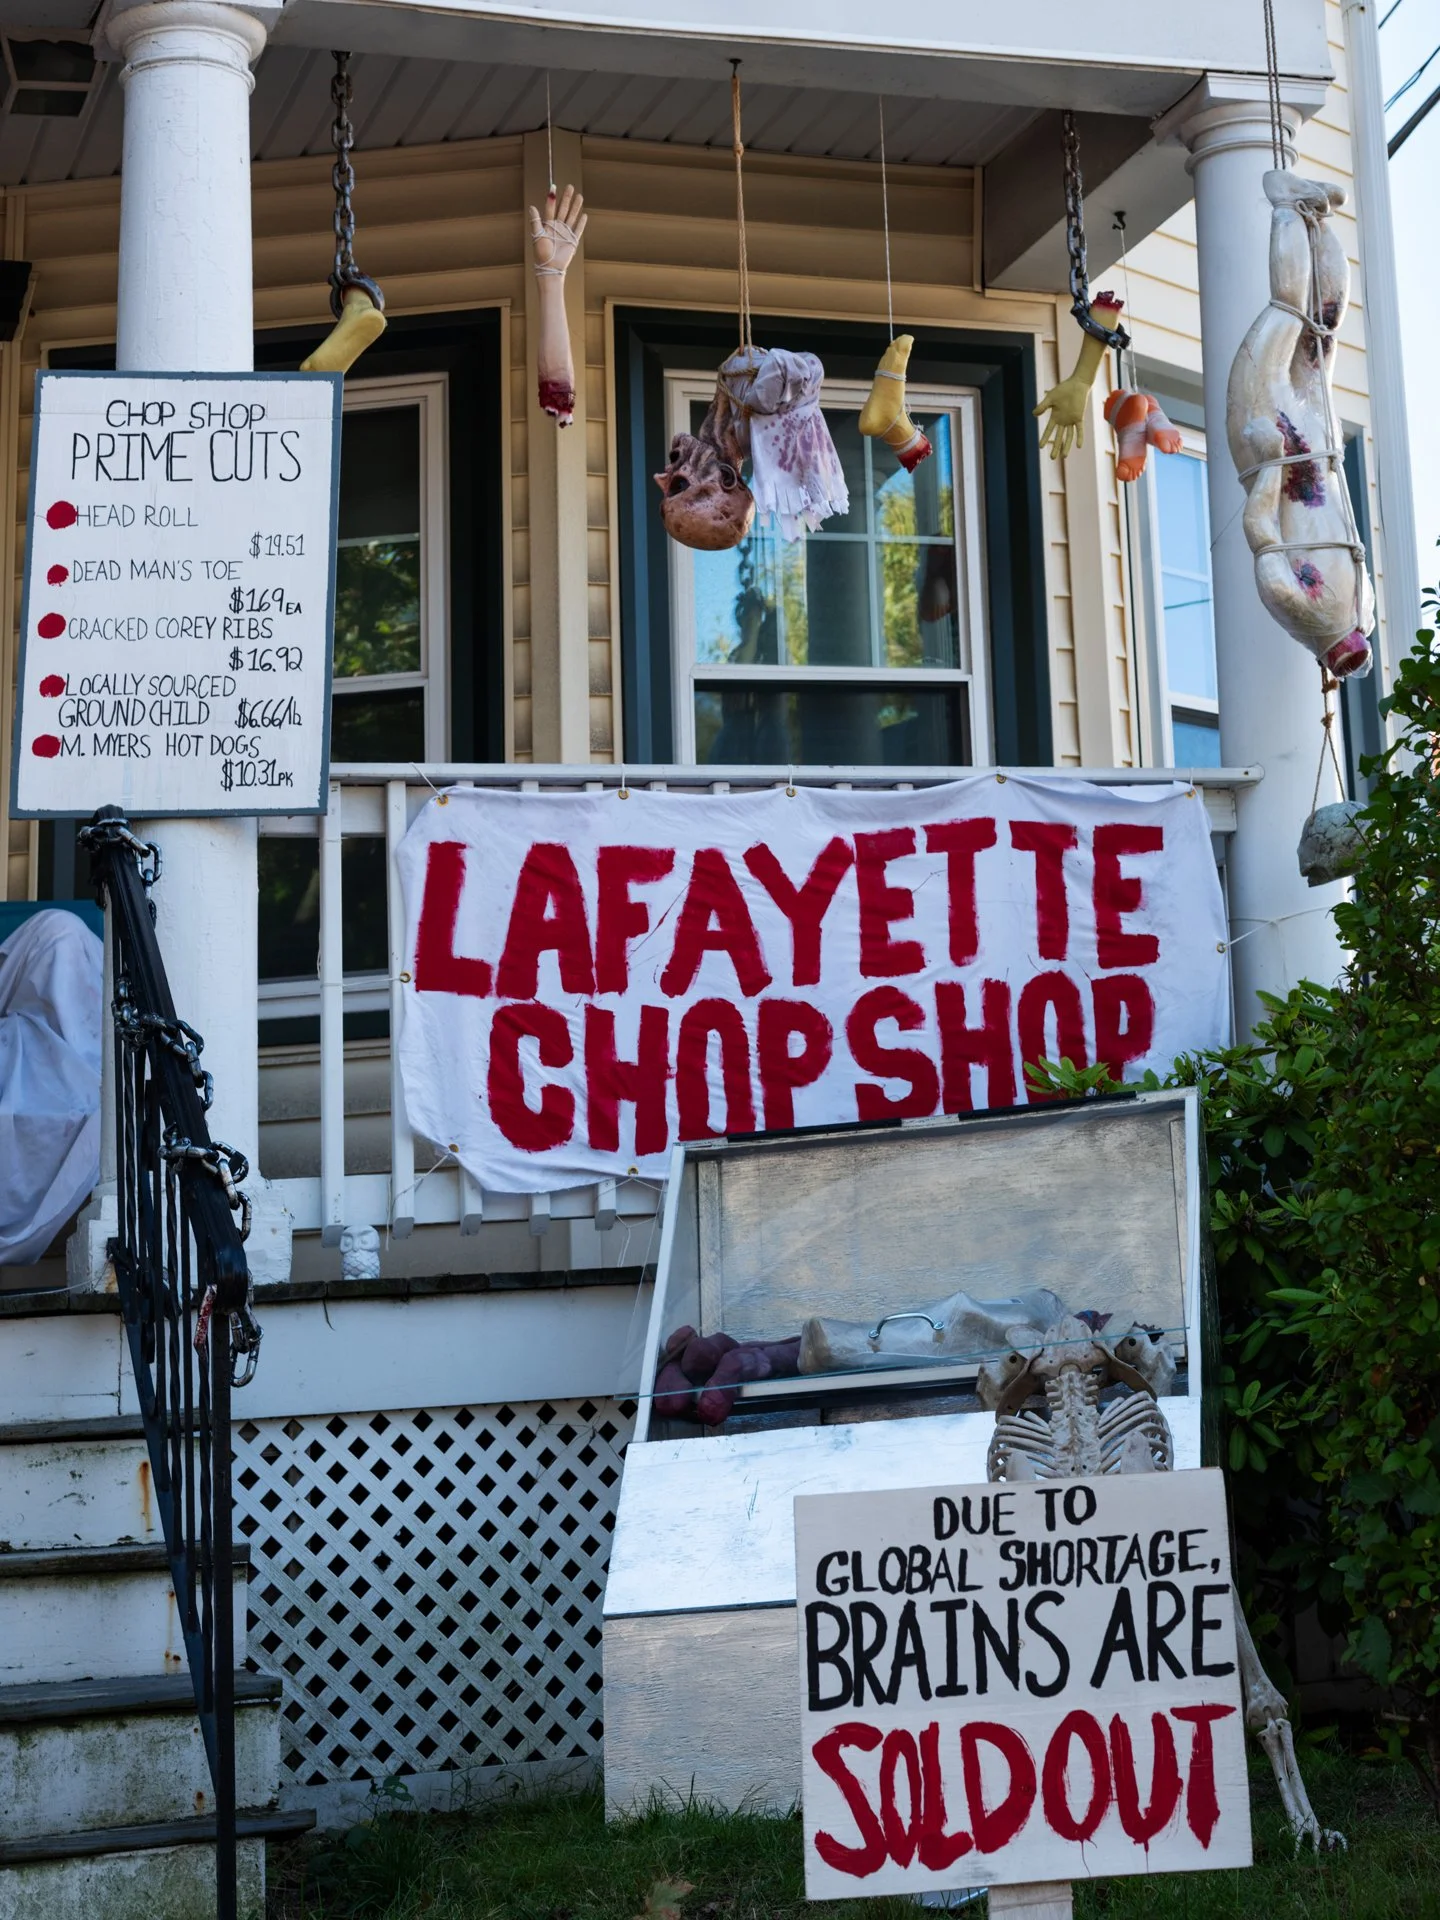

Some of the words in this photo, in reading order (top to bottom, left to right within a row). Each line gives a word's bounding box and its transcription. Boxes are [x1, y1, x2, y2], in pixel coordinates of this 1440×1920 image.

[105, 399, 176, 428] CHOP
[188, 401, 266, 430] SHOP
[71, 430, 195, 482] PRIME
[209, 430, 301, 482] CUTS
[76, 504, 136, 528] HEAD
[144, 504, 199, 528] ROLL
[249, 531, 305, 559] $19.51
[72, 559, 121, 583] DEAD
[129, 559, 193, 583] MAN'S
[200, 560, 243, 581] TOE
[68, 617, 148, 641] CRACKED
[155, 616, 217, 640] COREY
[222, 617, 274, 641] RIBS
[228, 646, 304, 673] $16.92
[64, 673, 146, 697] LOCALLY
[147, 675, 237, 698] SOURCED
[57, 698, 146, 728] GROUND
[148, 698, 211, 727] CHILD
[60, 733, 86, 758] M.
[93, 733, 152, 759] MYERS
[165, 734, 204, 758] HOT
[210, 734, 262, 759] DOGS
[414, 817, 1164, 999] LAFAYETTE
[933, 1491, 1017, 1540] DUE
[1034, 1484, 1097, 1532] TO
[815, 1544, 984, 1596] GLOBAL
[999, 1528, 1222, 1592] SHORTAGE,
[804, 1590, 1071, 1712] BRAINS
[1089, 1580, 1236, 1689] ARE
[811, 1719, 1038, 1879] SOLD
[1041, 1704, 1238, 1852] OUT
